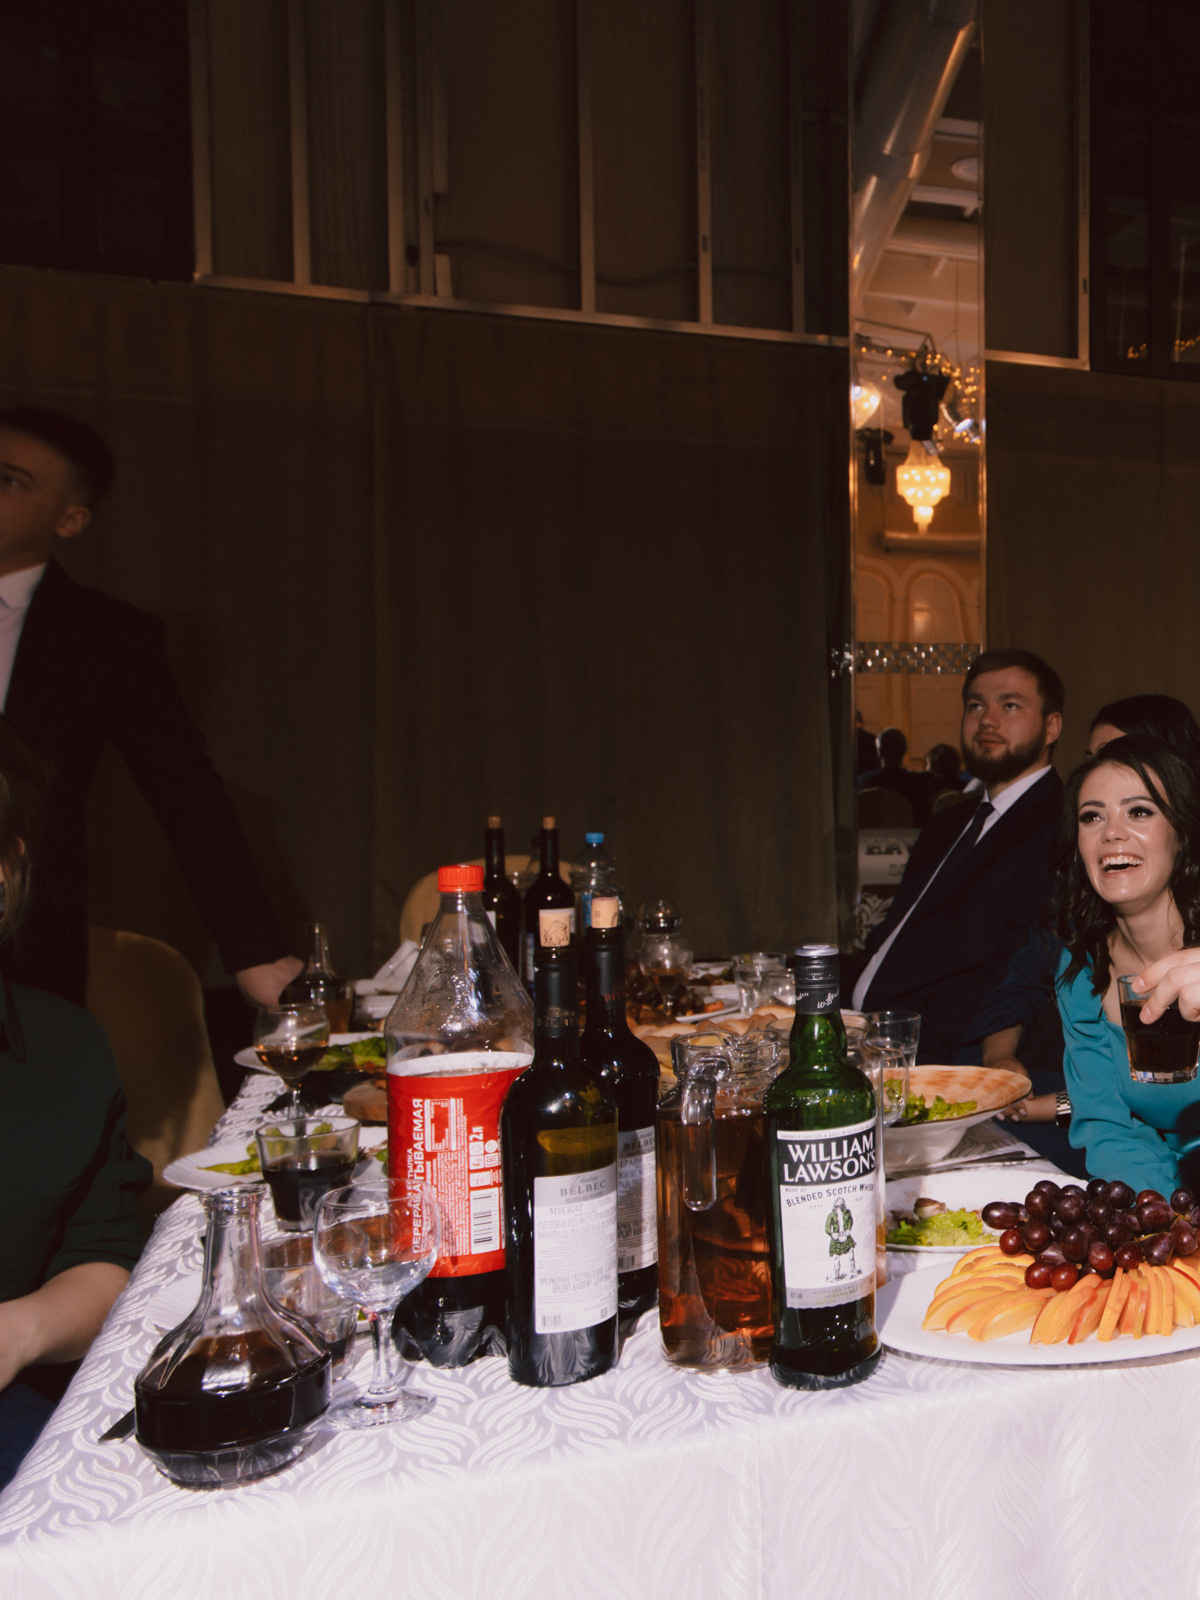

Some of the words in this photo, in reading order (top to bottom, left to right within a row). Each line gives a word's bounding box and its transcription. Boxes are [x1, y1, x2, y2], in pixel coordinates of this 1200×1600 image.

[623, 1138, 654, 1151] BELBE
[787, 1131, 874, 1163] WILLIAM
[783, 1149, 876, 1183] LAWSON'S
[560, 1180, 606, 1197] BELBEC
[786, 1191, 823, 1207] BLENDED
[826, 1185, 857, 1197] SCOTCH
[549, 1204, 584, 1216] МУСКАТ
